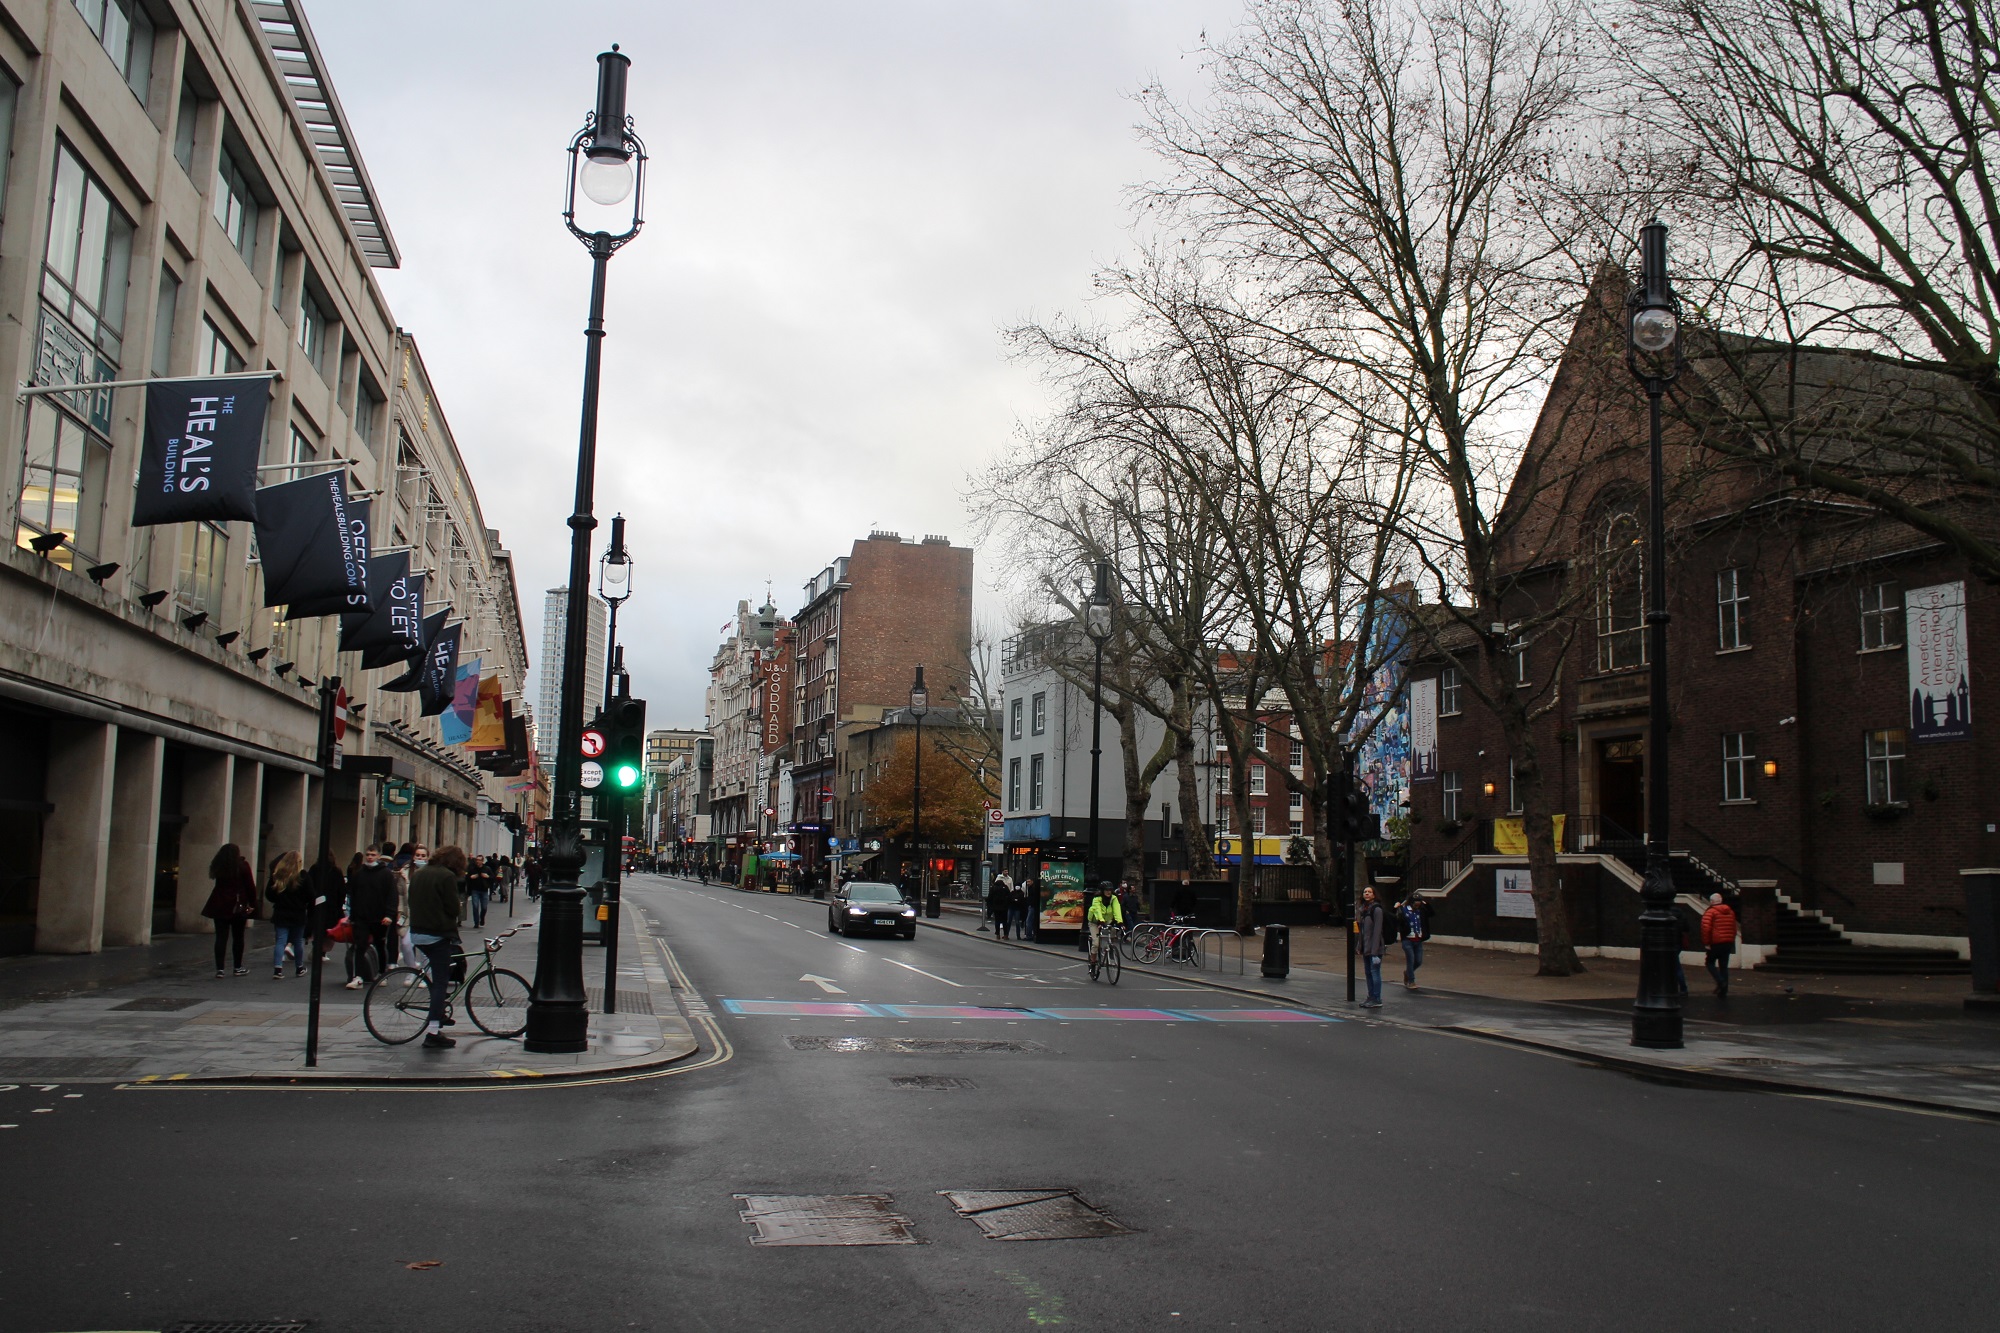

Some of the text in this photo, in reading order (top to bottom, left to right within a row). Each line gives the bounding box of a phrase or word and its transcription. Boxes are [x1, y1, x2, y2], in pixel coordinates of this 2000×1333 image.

[222, 395, 235, 414] THE
[163, 438, 179, 493] BUILDING
[179, 397, 219, 492] HEAL'S
[328, 475, 358, 587] THEHEALSBUILDING.COM
[390, 577, 409, 638] TO LET
[1930, 590, 1943, 686] International
[1919, 613, 1931, 687] American
[1945, 627, 1957, 684] Church
[904, 842, 946, 850] STRBUKS
